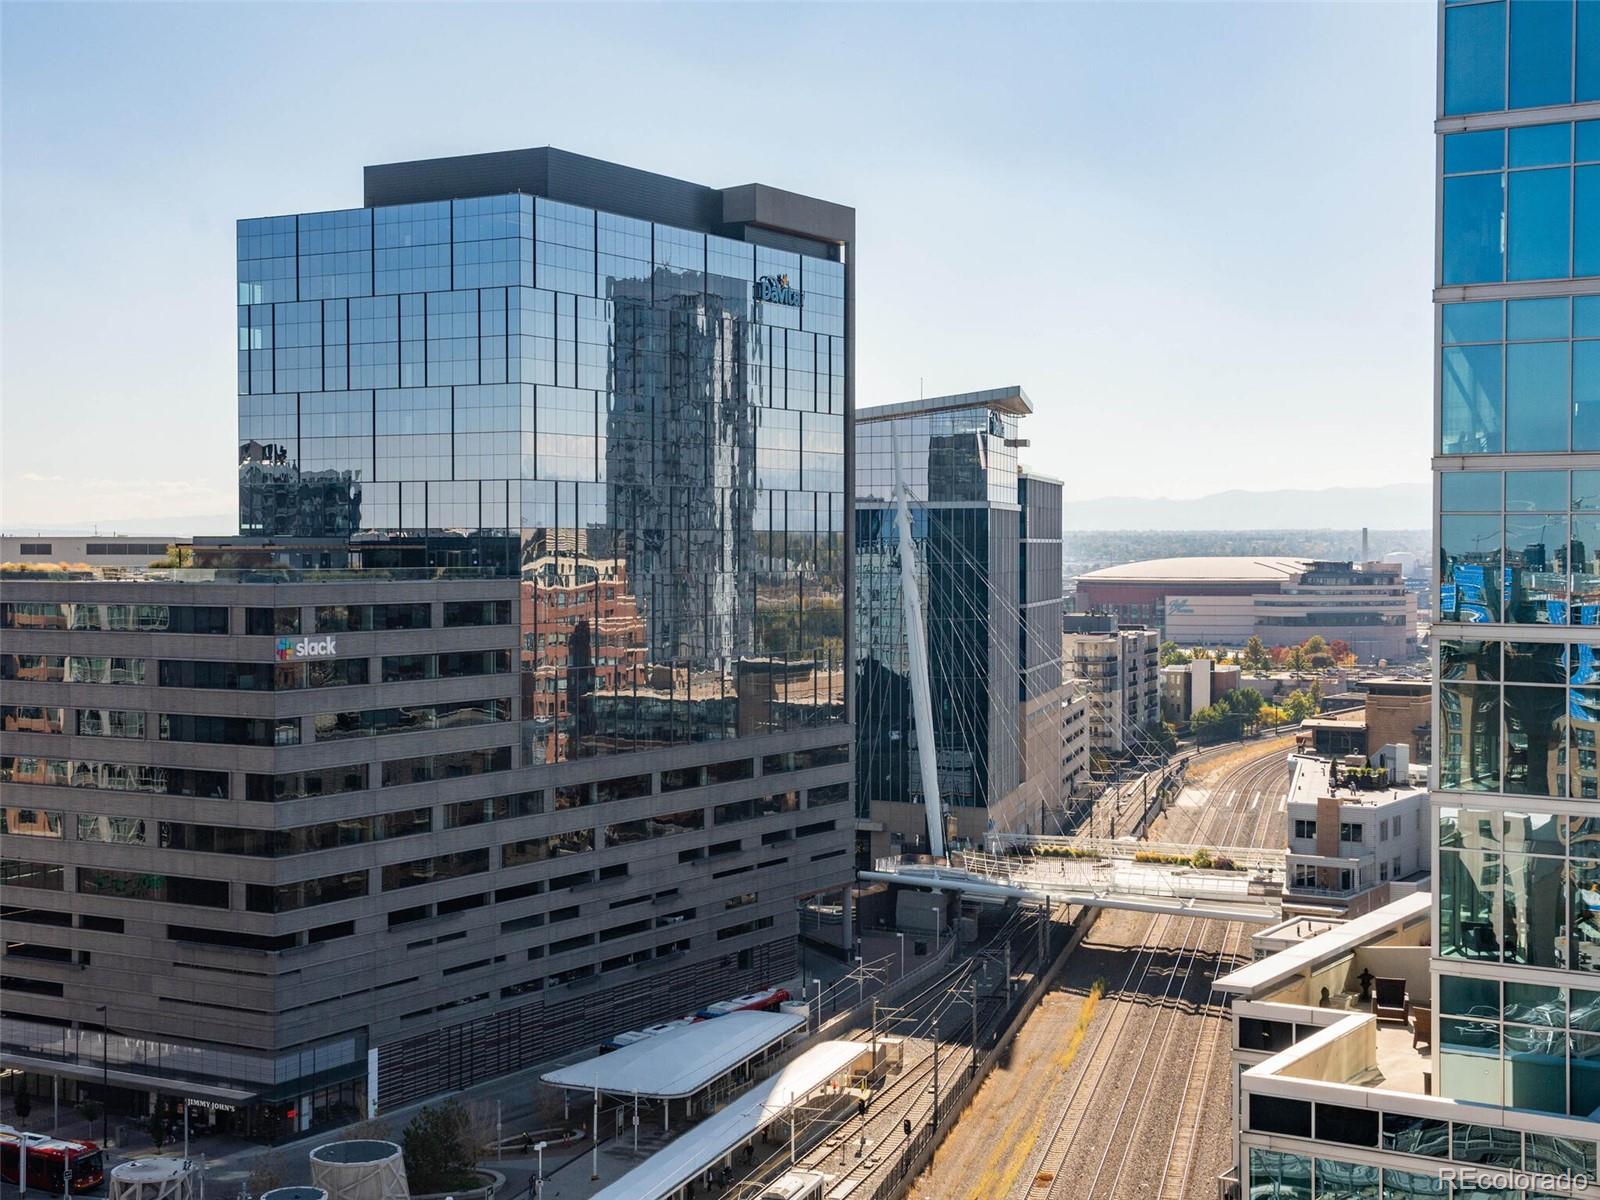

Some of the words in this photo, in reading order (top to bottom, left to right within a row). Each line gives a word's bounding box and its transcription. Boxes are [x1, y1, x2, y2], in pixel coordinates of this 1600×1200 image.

[296, 636, 336, 656] slack
[187, 1098, 211, 1108] JIMMY
[211, 1102, 236, 1112] JOHN'S
